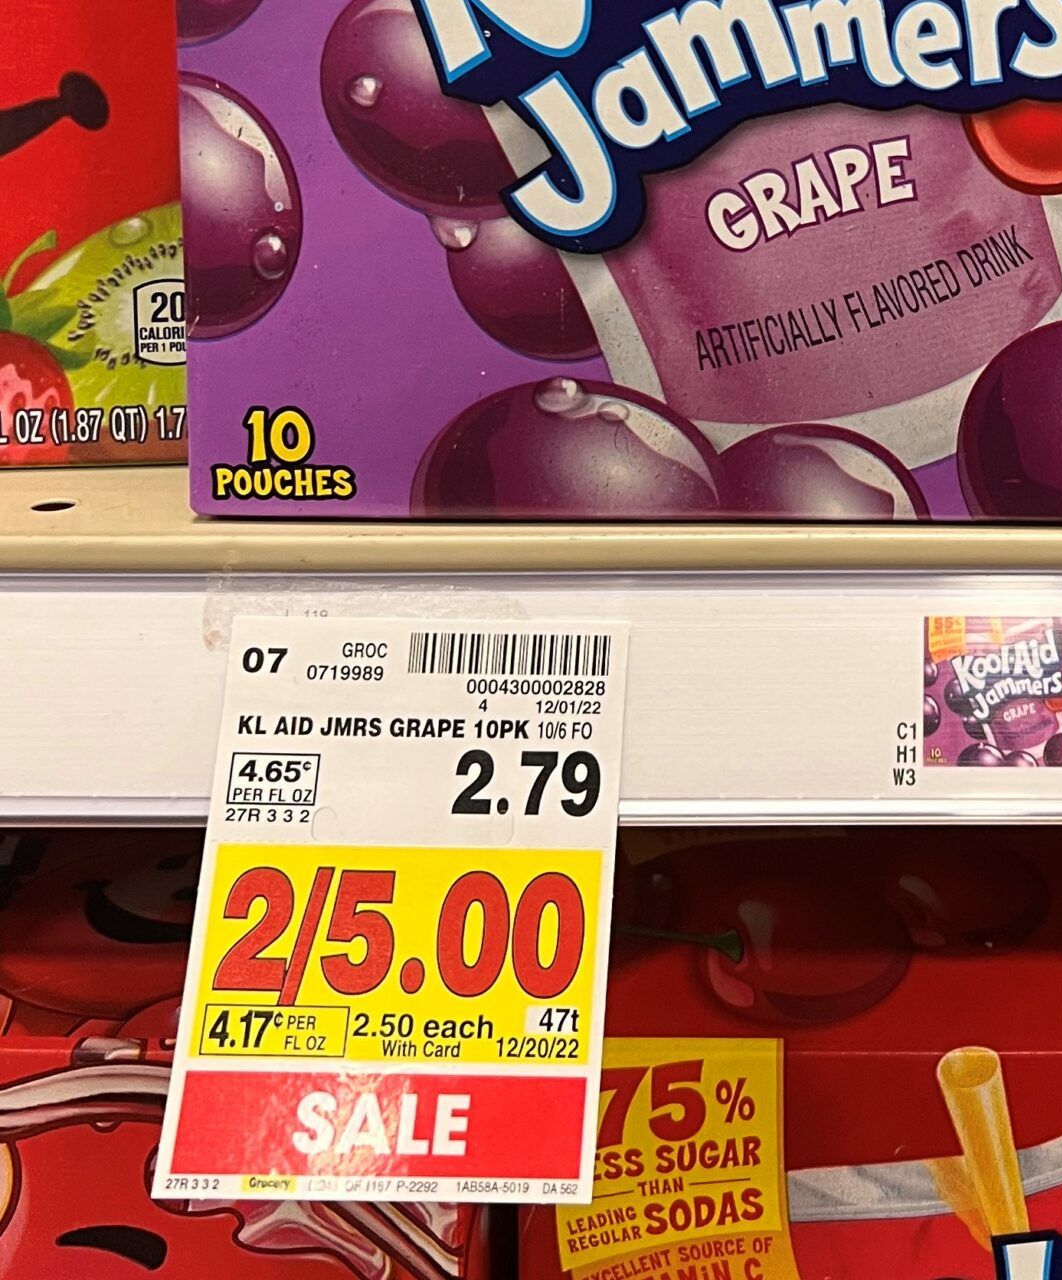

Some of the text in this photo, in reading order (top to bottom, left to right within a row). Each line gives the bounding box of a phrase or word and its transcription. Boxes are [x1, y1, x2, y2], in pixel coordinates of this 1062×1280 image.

[706, 137, 916, 251] GRAPE
[151, 292, 186, 323] 20
[695, 224, 1034, 370] ARTIFICIALLY FLAVORED DRINK
[140, 342, 158, 353] PER
[15, 410, 43, 443] OZ
[51, 409, 101, 444] (1.87
[111, 406, 147, 442] QT)
[247, 410, 311, 462] 10
[216, 468, 353, 496] POUCHES
[242, 647, 288, 674] 07
[342, 642, 388, 659] GROC
[306, 664, 384, 682] 0719989
[951, 631, 1060, 693] Kool-Aid
[466, 678, 606, 697] 0004300002828
[973, 671, 1062, 720] Jammers
[479, 700, 602, 716] 4 12/01/22
[1003, 703, 1035, 722] GRAPE
[238, 716, 593, 740] KL AID JMRS GRAPE 10PK 10/6 FO
[897, 723, 916, 740] C1
[897, 747, 916, 763] H1
[451, 749, 602, 817] 2.79
[893, 770, 916, 786] W3
[232, 788, 313, 803] PER FL OZ
[225, 808, 310, 822] 27R 3 3 2
[212, 866, 585, 1006] 2/5.00
[287, 1016, 316, 1030] PER
[353, 1013, 494, 1039] 2.50 each
[540, 1008, 579, 1032] 47t
[285, 1037, 326, 1051] FL OZ
[383, 1041, 461, 1058] With Card
[496, 1038, 579, 1059] 12/20/22
[292, 1092, 471, 1156] SALE
[594, 1135, 761, 1181] ESS SUGAR
[166, 1178, 188, 1189] 27R
[396, 1181, 438, 1193] P-2292
[637, 1177, 684, 1196] THAN
[567, 1188, 764, 1253] REGULAR SODAS
[679, 1238, 745, 1263] SOURCE
[752, 1237, 773, 1253] OF
